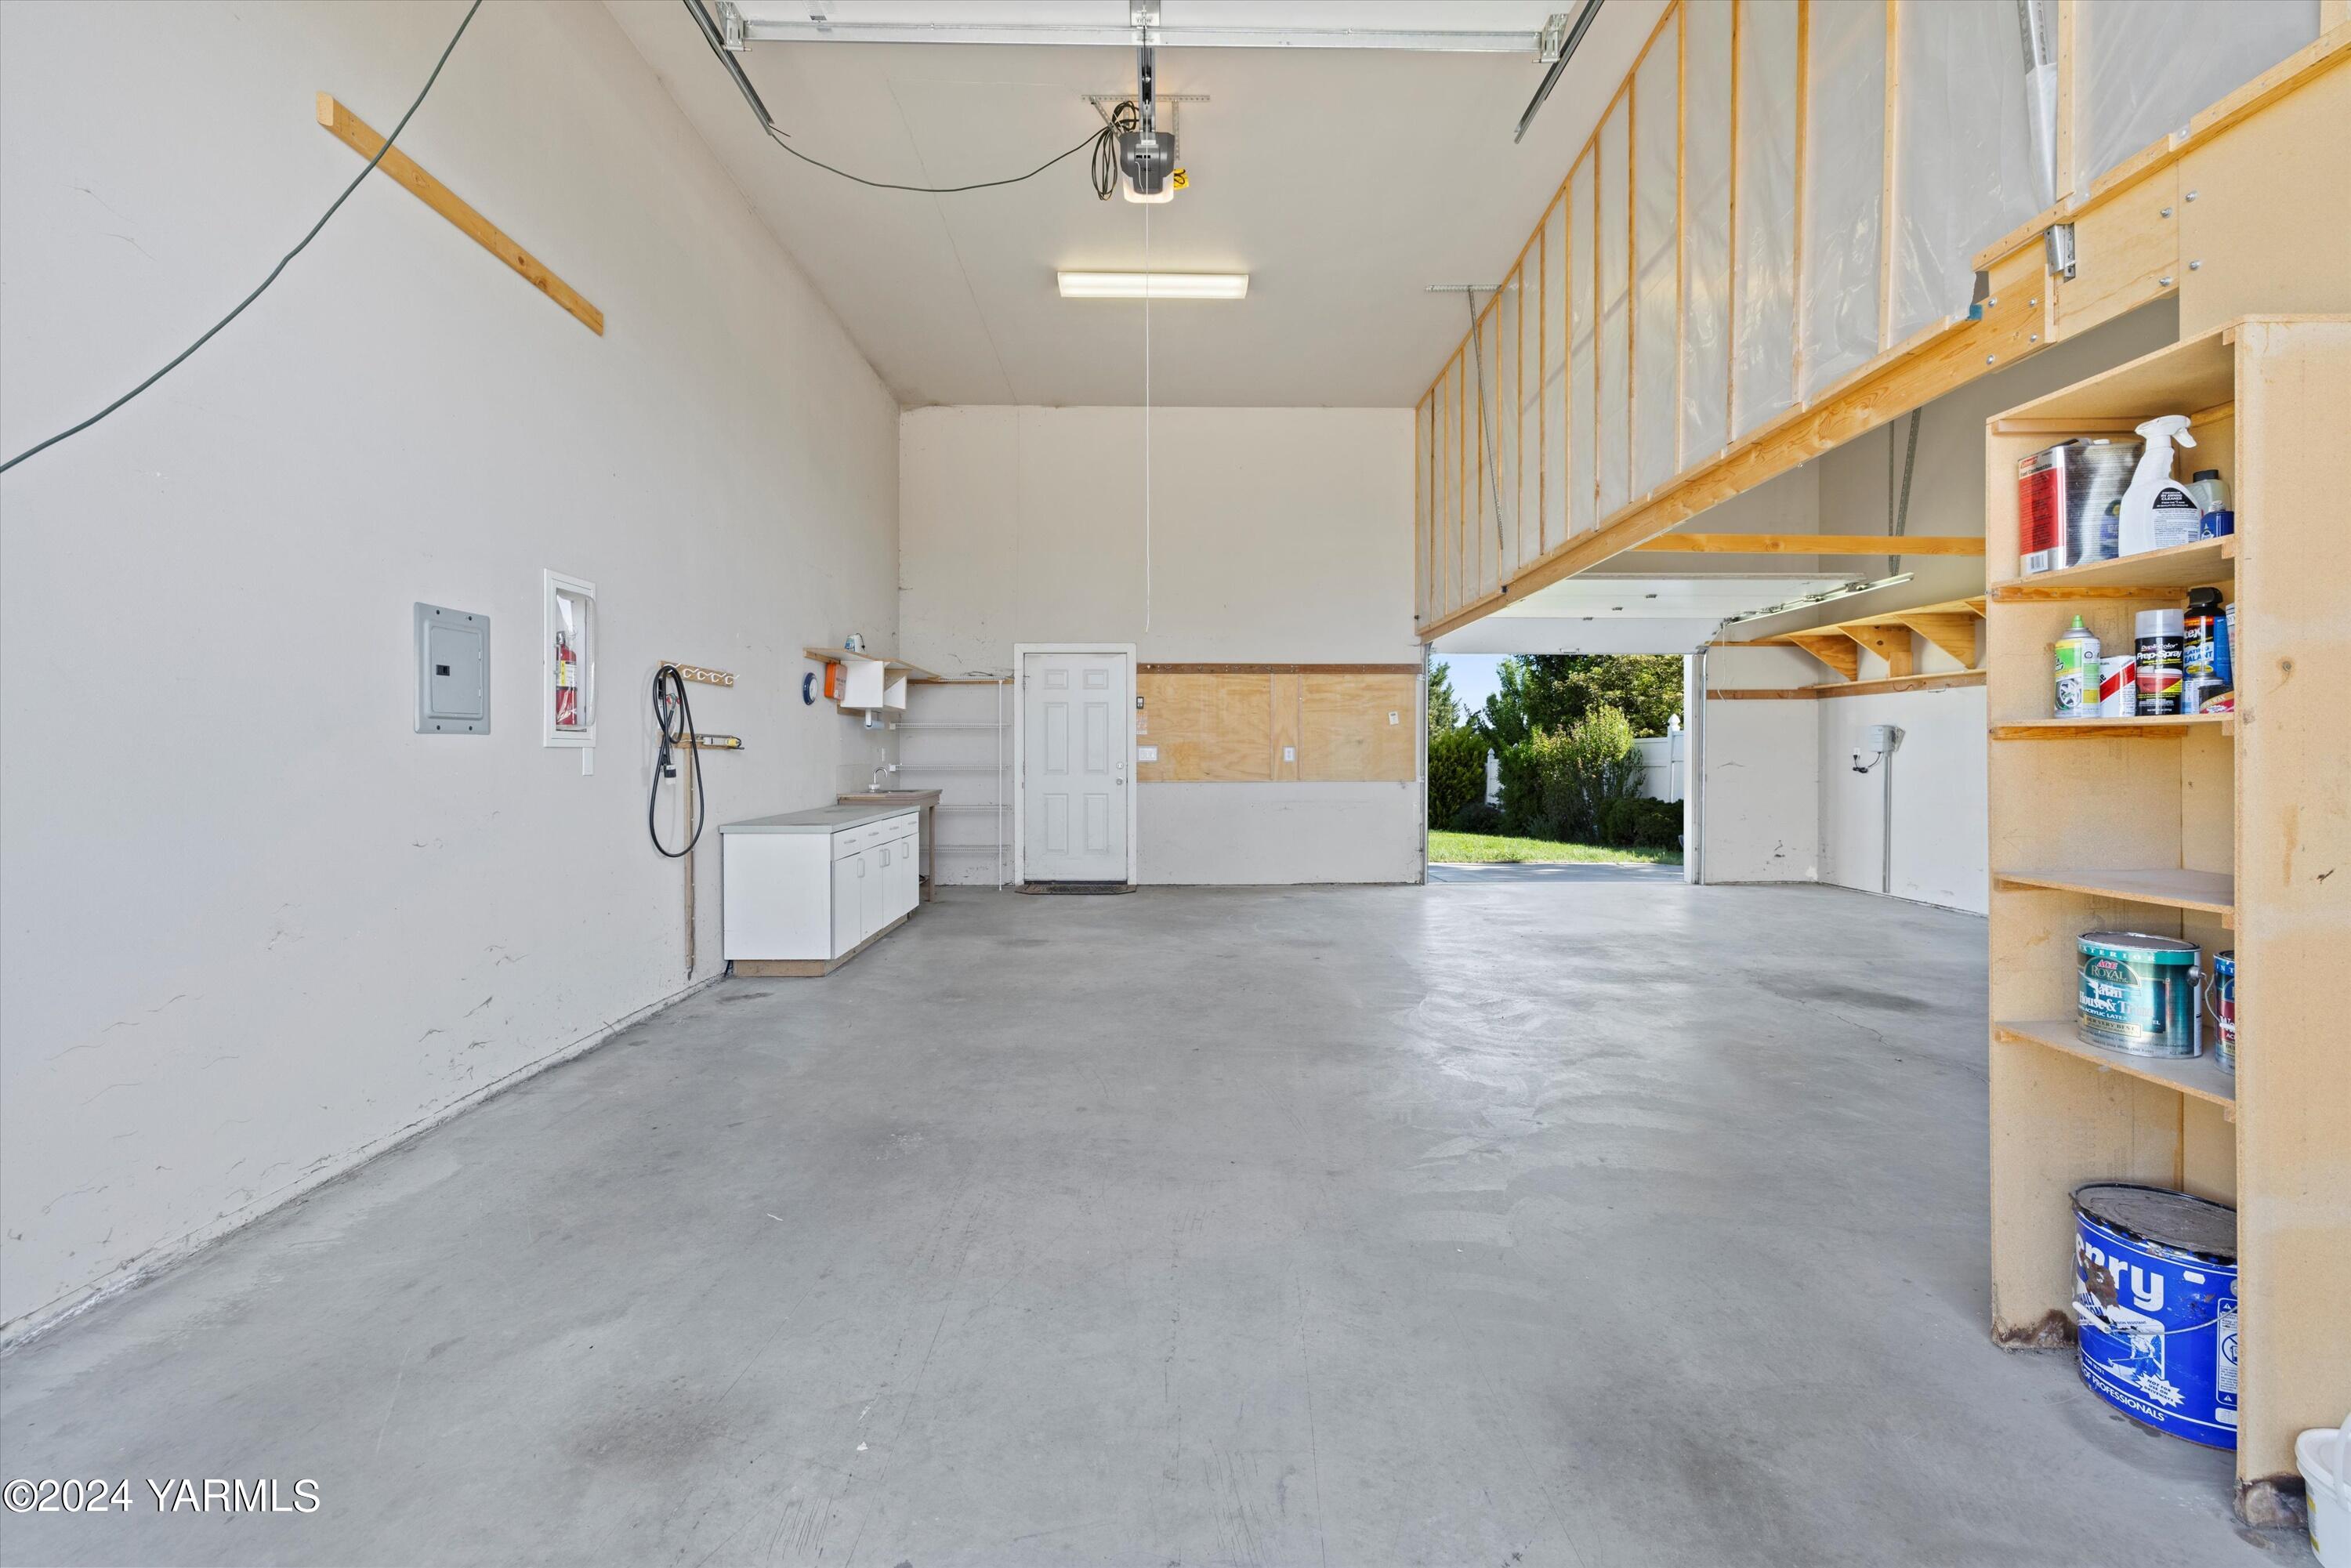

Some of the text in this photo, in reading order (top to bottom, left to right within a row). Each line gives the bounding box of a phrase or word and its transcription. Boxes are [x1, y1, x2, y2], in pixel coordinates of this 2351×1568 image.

[2136, 650, 2183, 660] Prep-Spray
[2078, 944, 2156, 961] EXTERIOR
[2096, 959, 2118, 970] ACE
[2091, 965, 2127, 980] ROYAL
[2106, 998, 2117, 1012] &
[2085, 1008, 2106, 1017] ACRYLIC
[2083, 1368, 2165, 1421] OF PROFESSIONALS
[2144, 1385, 2174, 1402] DRIVEWAYS
